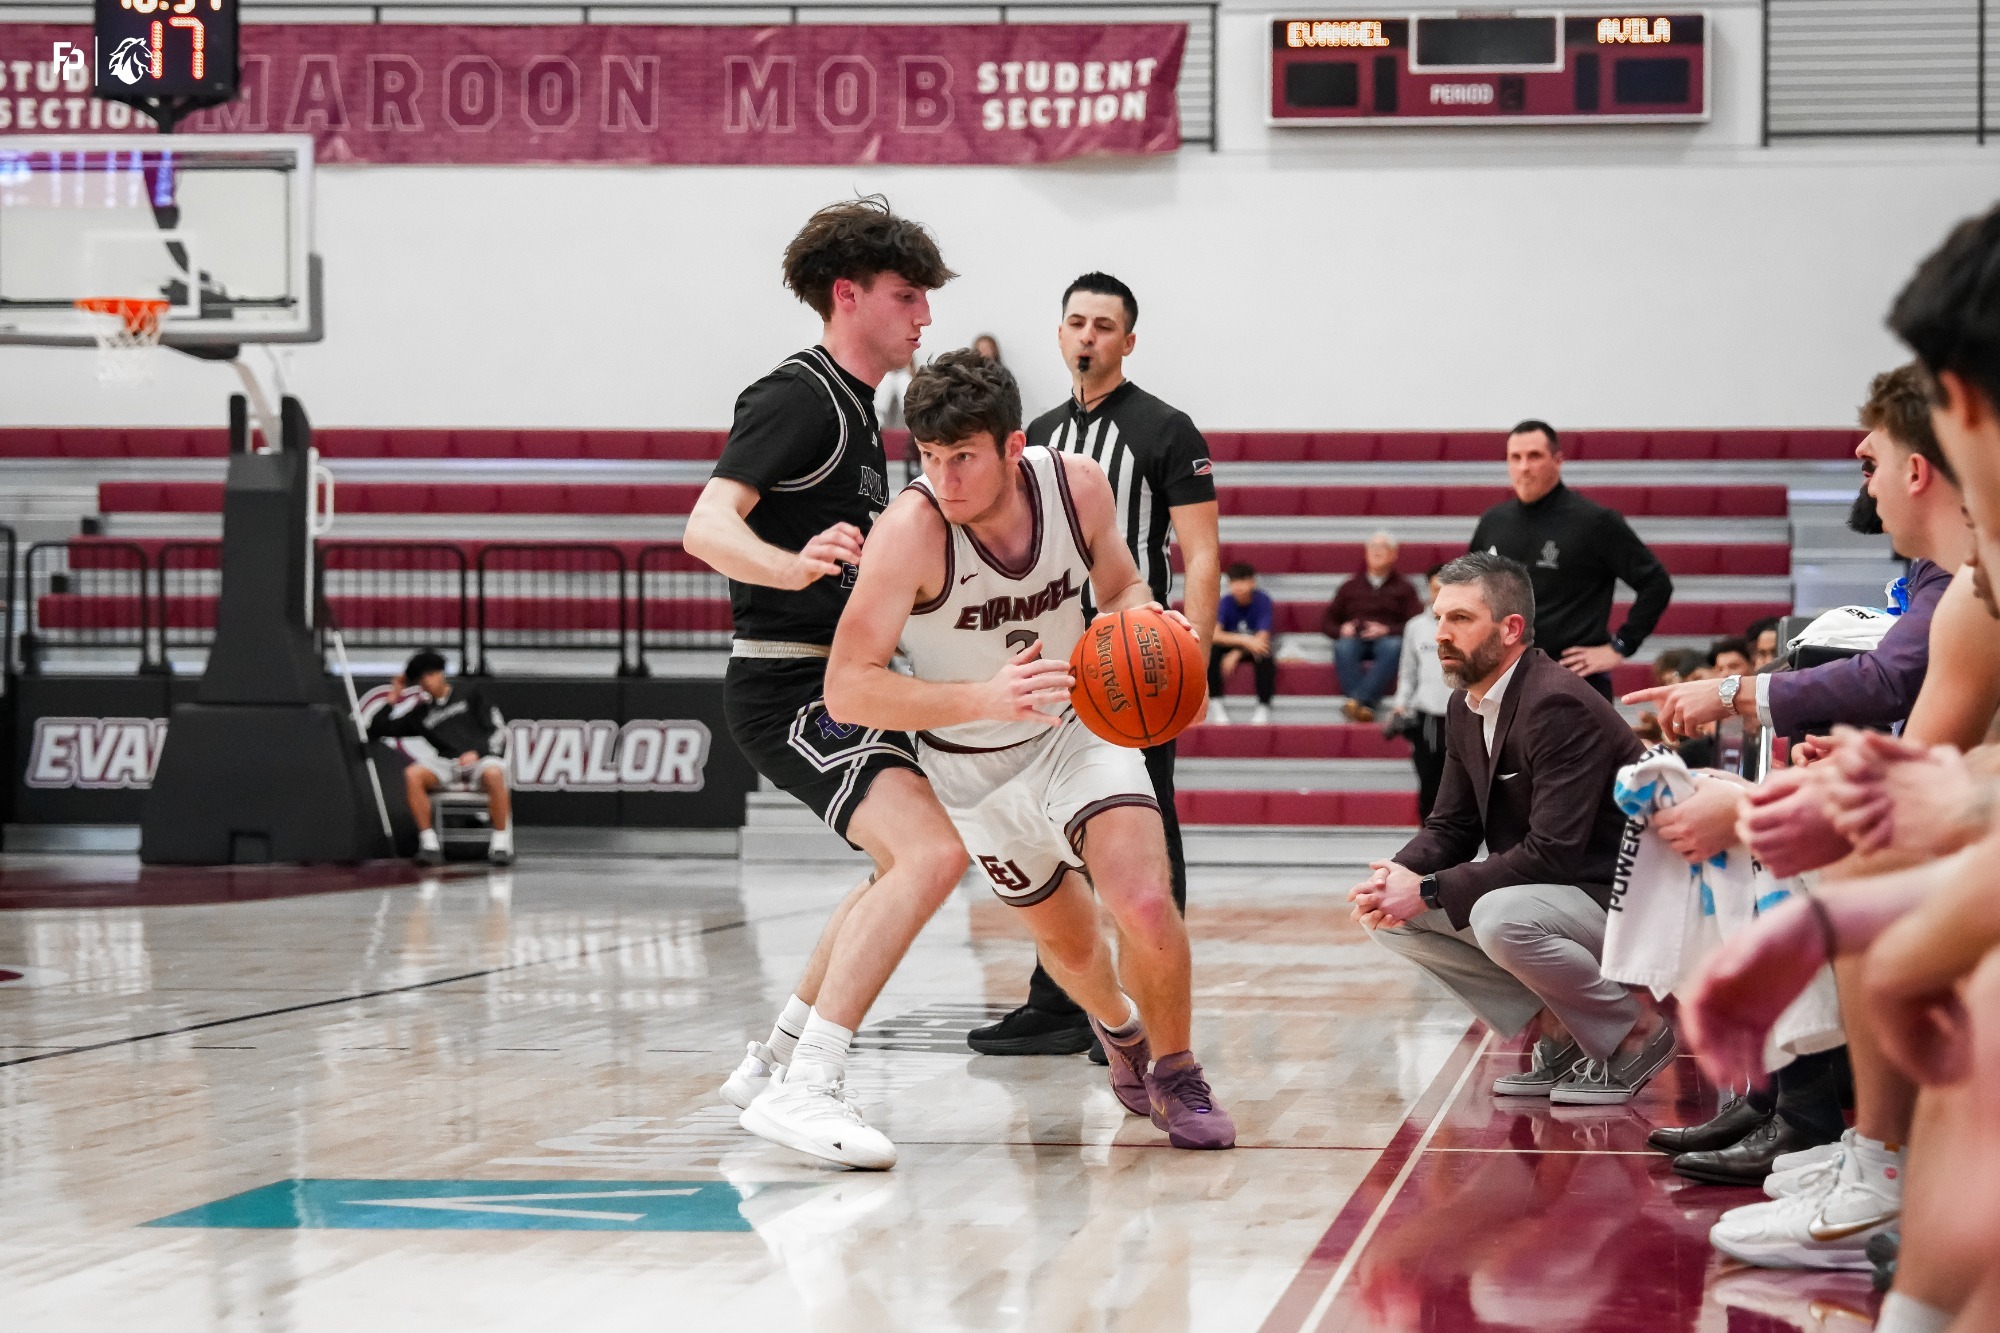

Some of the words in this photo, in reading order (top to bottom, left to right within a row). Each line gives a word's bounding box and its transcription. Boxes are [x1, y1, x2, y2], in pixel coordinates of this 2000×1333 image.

[151, 16, 205, 80] 17
[1287, 21, 1390, 47] EVANGEL
[1597, 18, 1671, 43] AVILA
[199, 54, 660, 134] MAROON
[722, 54, 955, 134] MOB
[977, 57, 1158, 94] STUDENT
[1429, 83, 1495, 105] PERIOD
[982, 90, 1148, 131] SECTION
[857, 465, 889, 507] AVIL
[953, 567, 1081, 632] EVANGEL
[1095, 623, 1132, 714] SPALDING
[1132, 622, 1160, 699] LEGACY
[506, 718, 712, 792] VALOR
[976, 854, 1032, 892] EU
